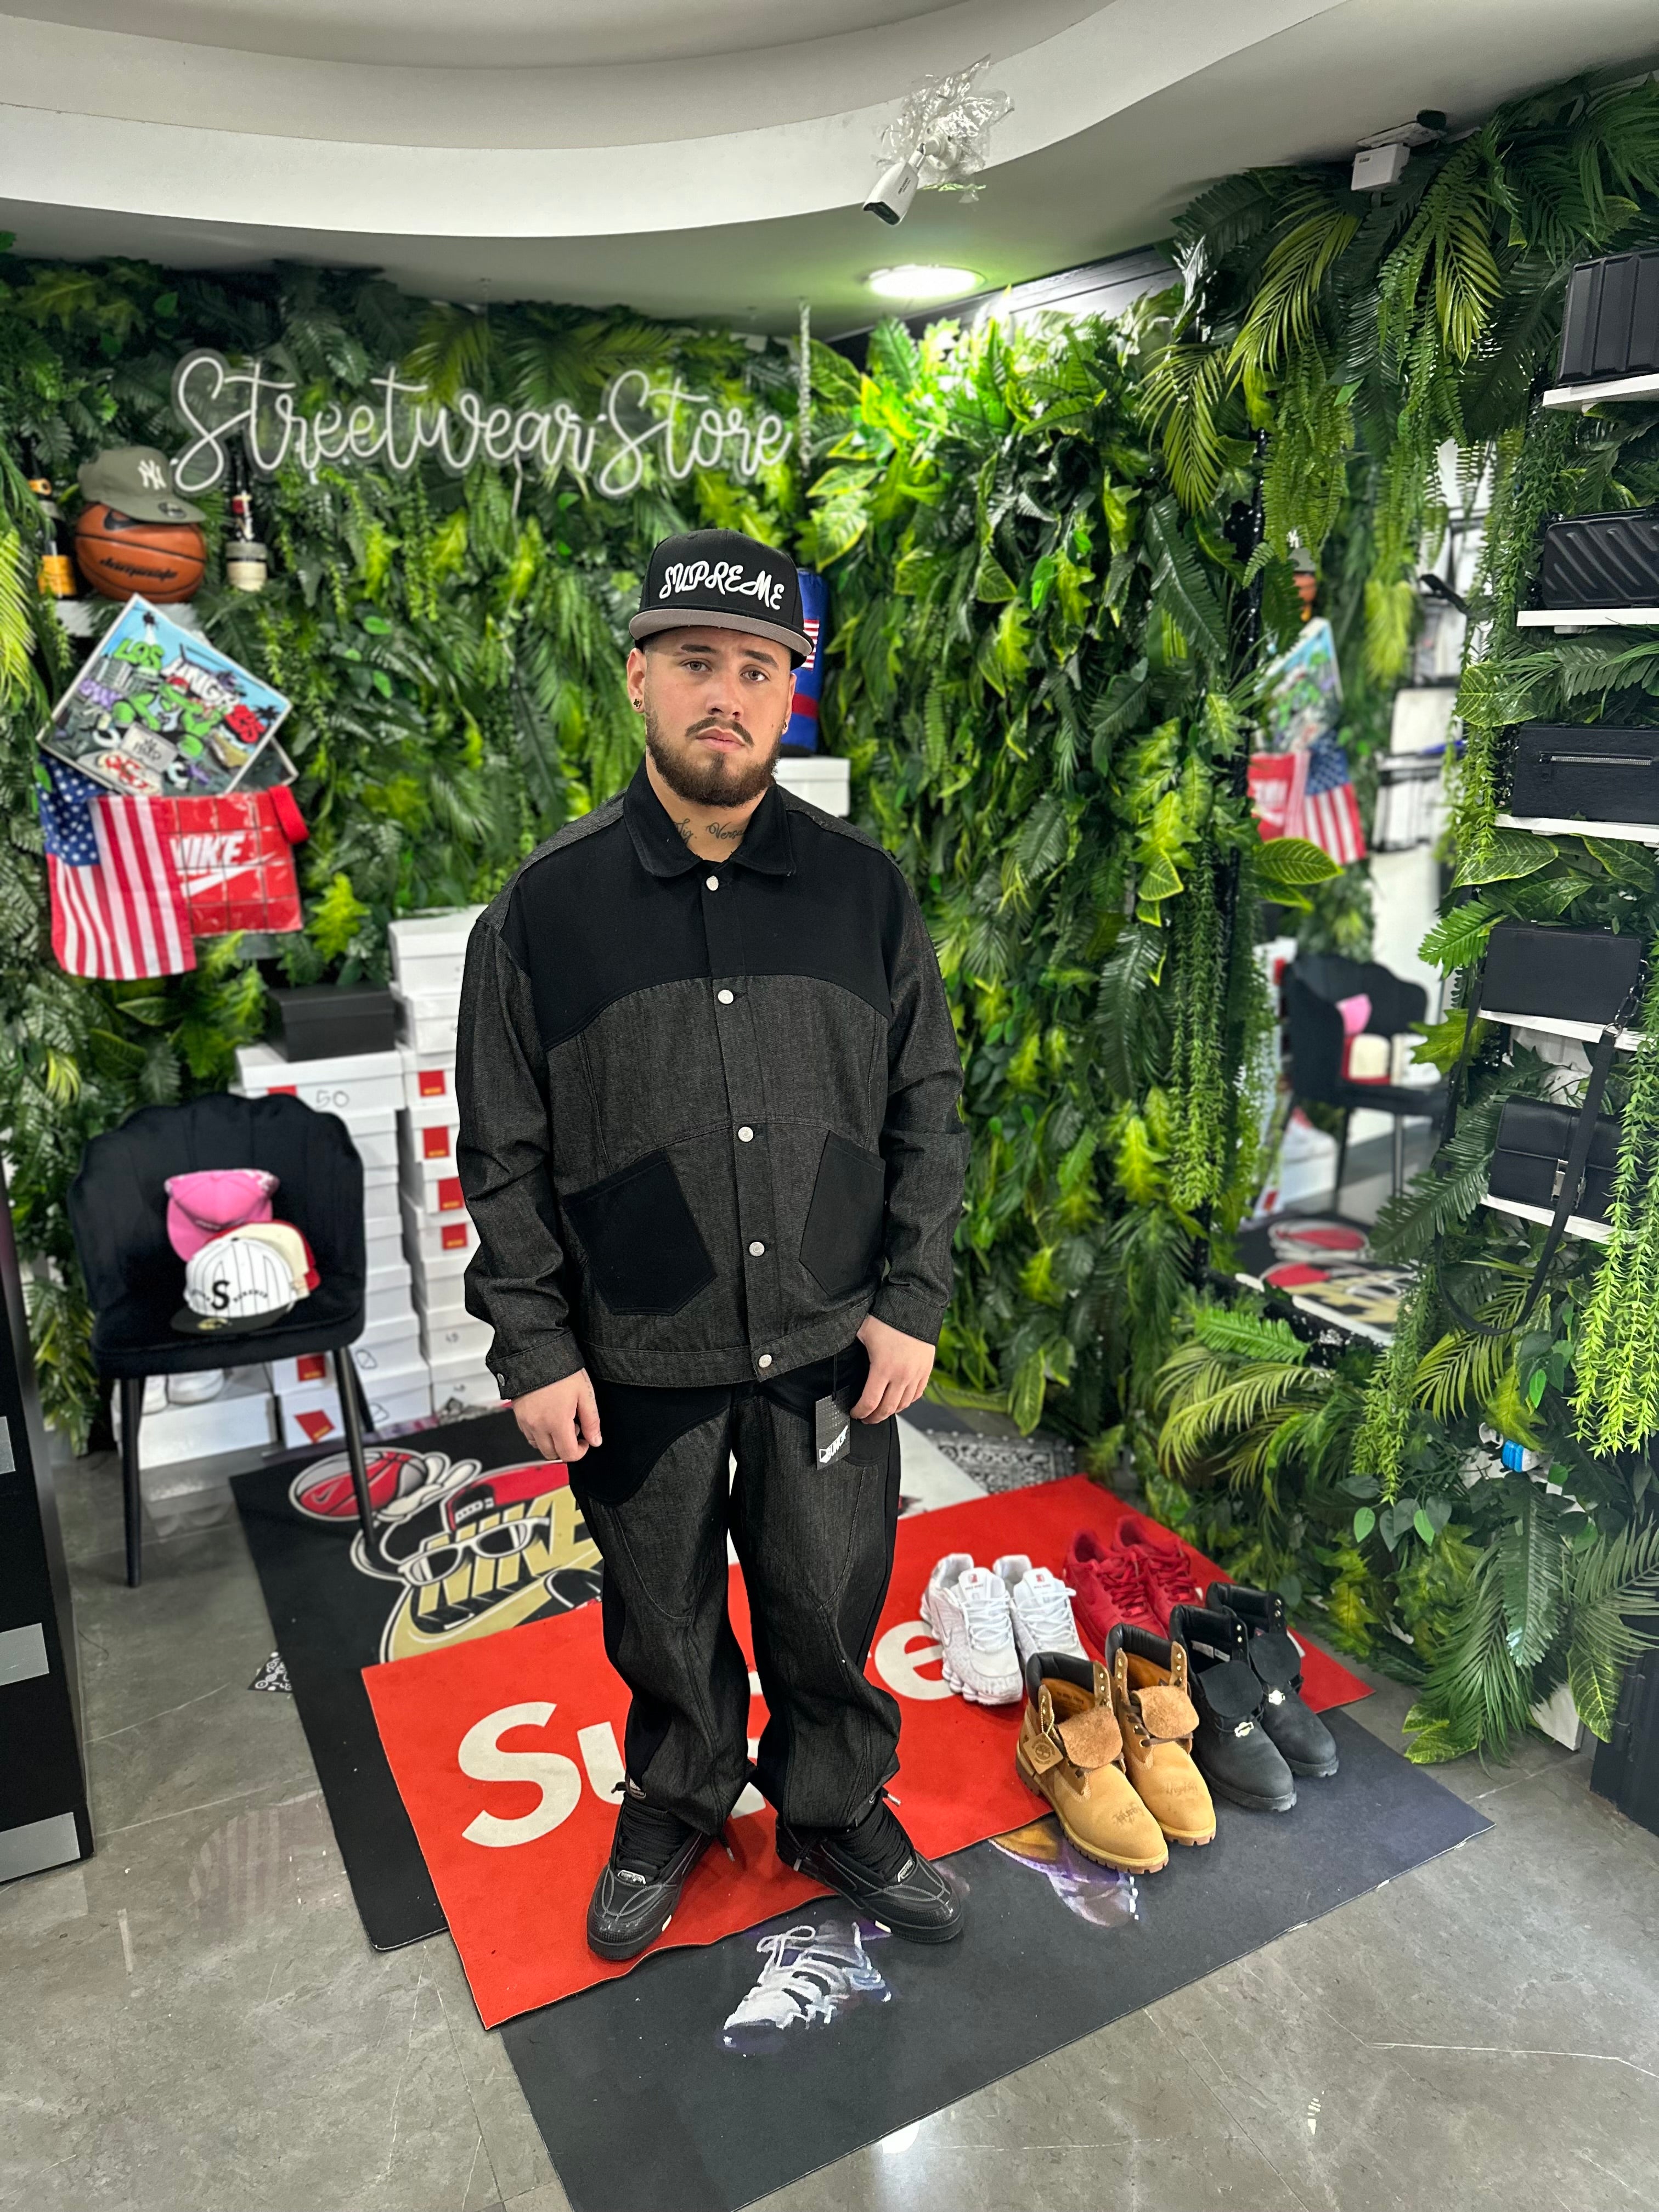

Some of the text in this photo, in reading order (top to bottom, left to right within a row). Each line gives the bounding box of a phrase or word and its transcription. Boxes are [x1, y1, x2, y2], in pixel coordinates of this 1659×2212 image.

[175, 357, 793, 496] Streetwear Store
[138, 459, 167, 490] NY
[659, 560, 785, 610] SUPREME
[114, 637, 165, 675] LOS
[316, 1089, 349, 1108] 50
[211, 1279, 230, 1311] S
